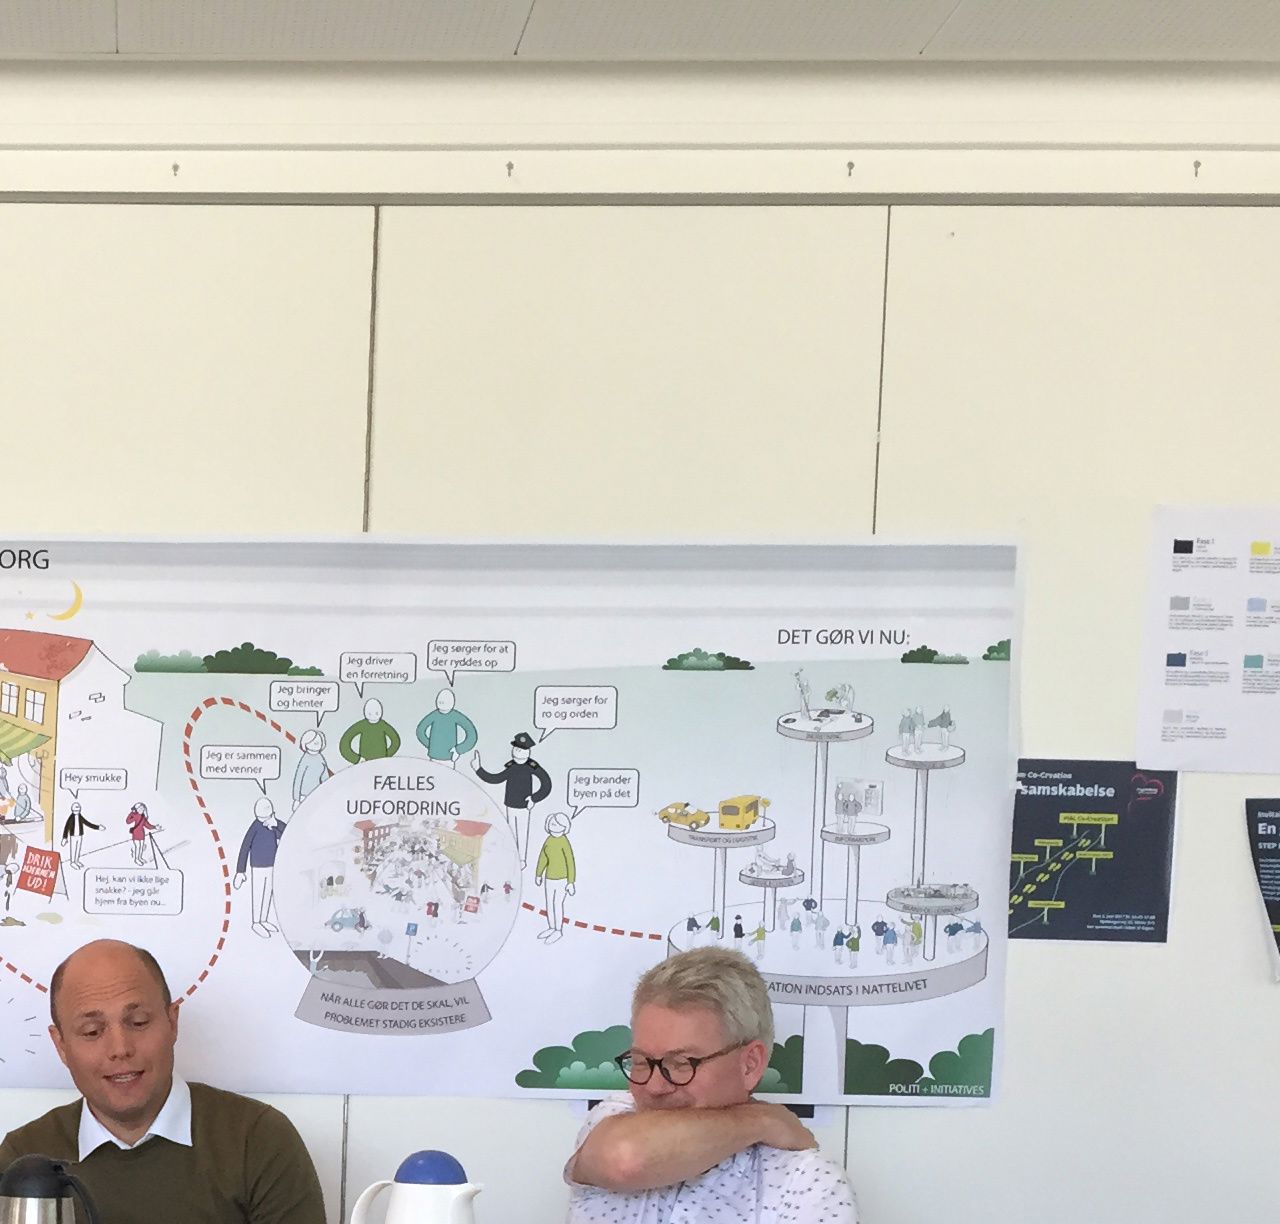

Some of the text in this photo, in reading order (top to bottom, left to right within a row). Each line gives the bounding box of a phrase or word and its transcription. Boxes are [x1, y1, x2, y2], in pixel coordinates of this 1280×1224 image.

[778, 628, 910, 646] DET GØR VI NU:
[432, 644, 508, 655] Jeg sørger for at
[346, 656, 393, 667] Jeg driver
[432, 658, 498, 669] der ryddes op
[361, 670, 409, 681] forretning
[277, 685, 331, 696] Jeg bringer
[277, 698, 324, 708] og henter
[542, 695, 608, 706] Jeg sørger for
[554, 711, 567, 720] og
[569, 710, 598, 718] orden
[206, 751, 277, 761] Jeg er sammen
[206, 765, 262, 774] med venner
[1028, 771, 1072, 779] Co-Creation
[64, 773, 122, 783] Hey smukke
[374, 775, 435, 791] FÆLLES
[574, 774, 631, 786] Jeg brander
[574, 788, 631, 799] byen på det
[1020, 783, 1116, 797] samskabelse
[346, 799, 461, 816] UDFORDRING
[1258, 823, 1276, 835] En
[26, 852, 53, 869] DRIK
[27, 875, 48, 891] UD!
[112, 875, 127, 883] kan
[95, 897, 115, 906] hjem
[117, 897, 127, 905] fra
[129, 898, 148, 907] byen
[768, 981, 802, 994] ATION
[805, 984, 853, 996] INDSATS
[864, 979, 927, 995] NATTELIVET
[320, 992, 341, 1005] NÅR
[343, 998, 365, 1009] ALLE
[367, 1000, 388, 1010] GØR
[391, 1002, 411, 1011] DET
[412, 1001, 425, 1010] DE
[454, 996, 470, 1006] VIL
[324, 1011, 467, 1029] PROBLEMET STADIG EKSISTERE
[889, 1084, 920, 1094] POLITI
[931, 1084, 985, 1096] INITIATIVES
